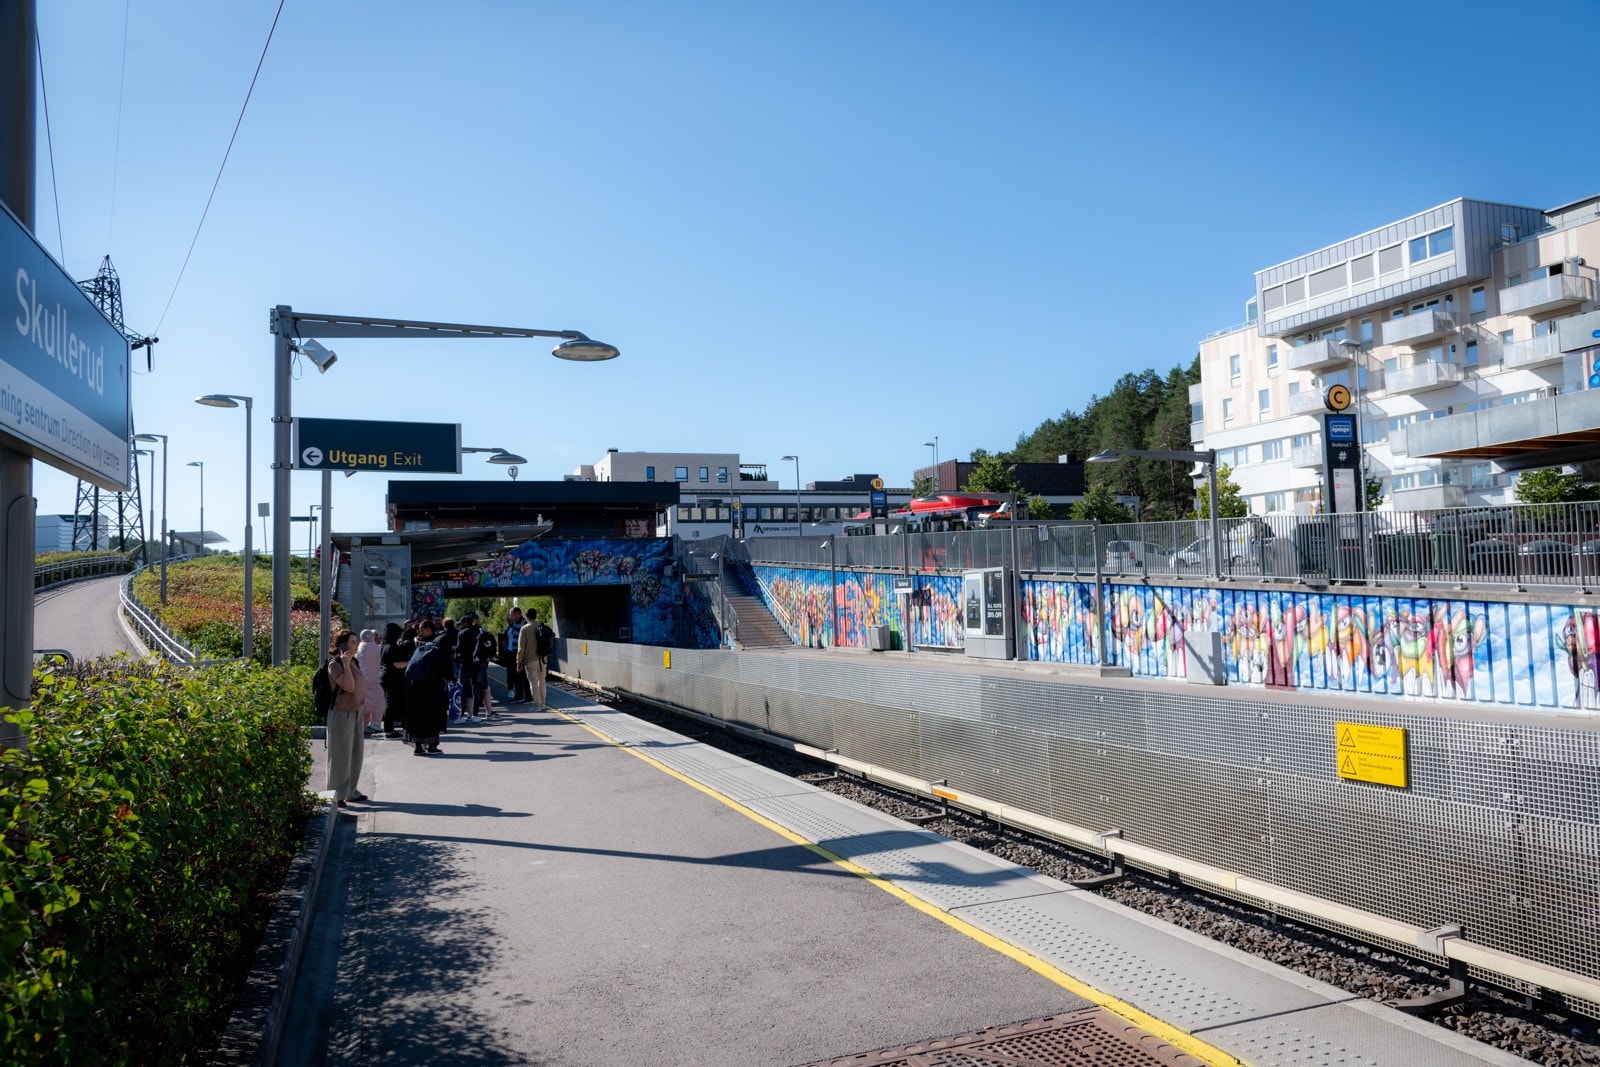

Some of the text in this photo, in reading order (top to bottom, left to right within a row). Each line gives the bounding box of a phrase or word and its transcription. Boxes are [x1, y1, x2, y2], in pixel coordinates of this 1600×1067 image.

[15, 267, 104, 397] Skullerud
[1334, 391, 1343, 404] C
[24, 402, 60, 438] sentrum
[61, 417, 91, 457] Direction
[92, 437, 103, 468] city
[103, 449, 120, 472] centre
[328, 449, 423, 468] Utgang Exit
[875, 480, 881, 488] B
